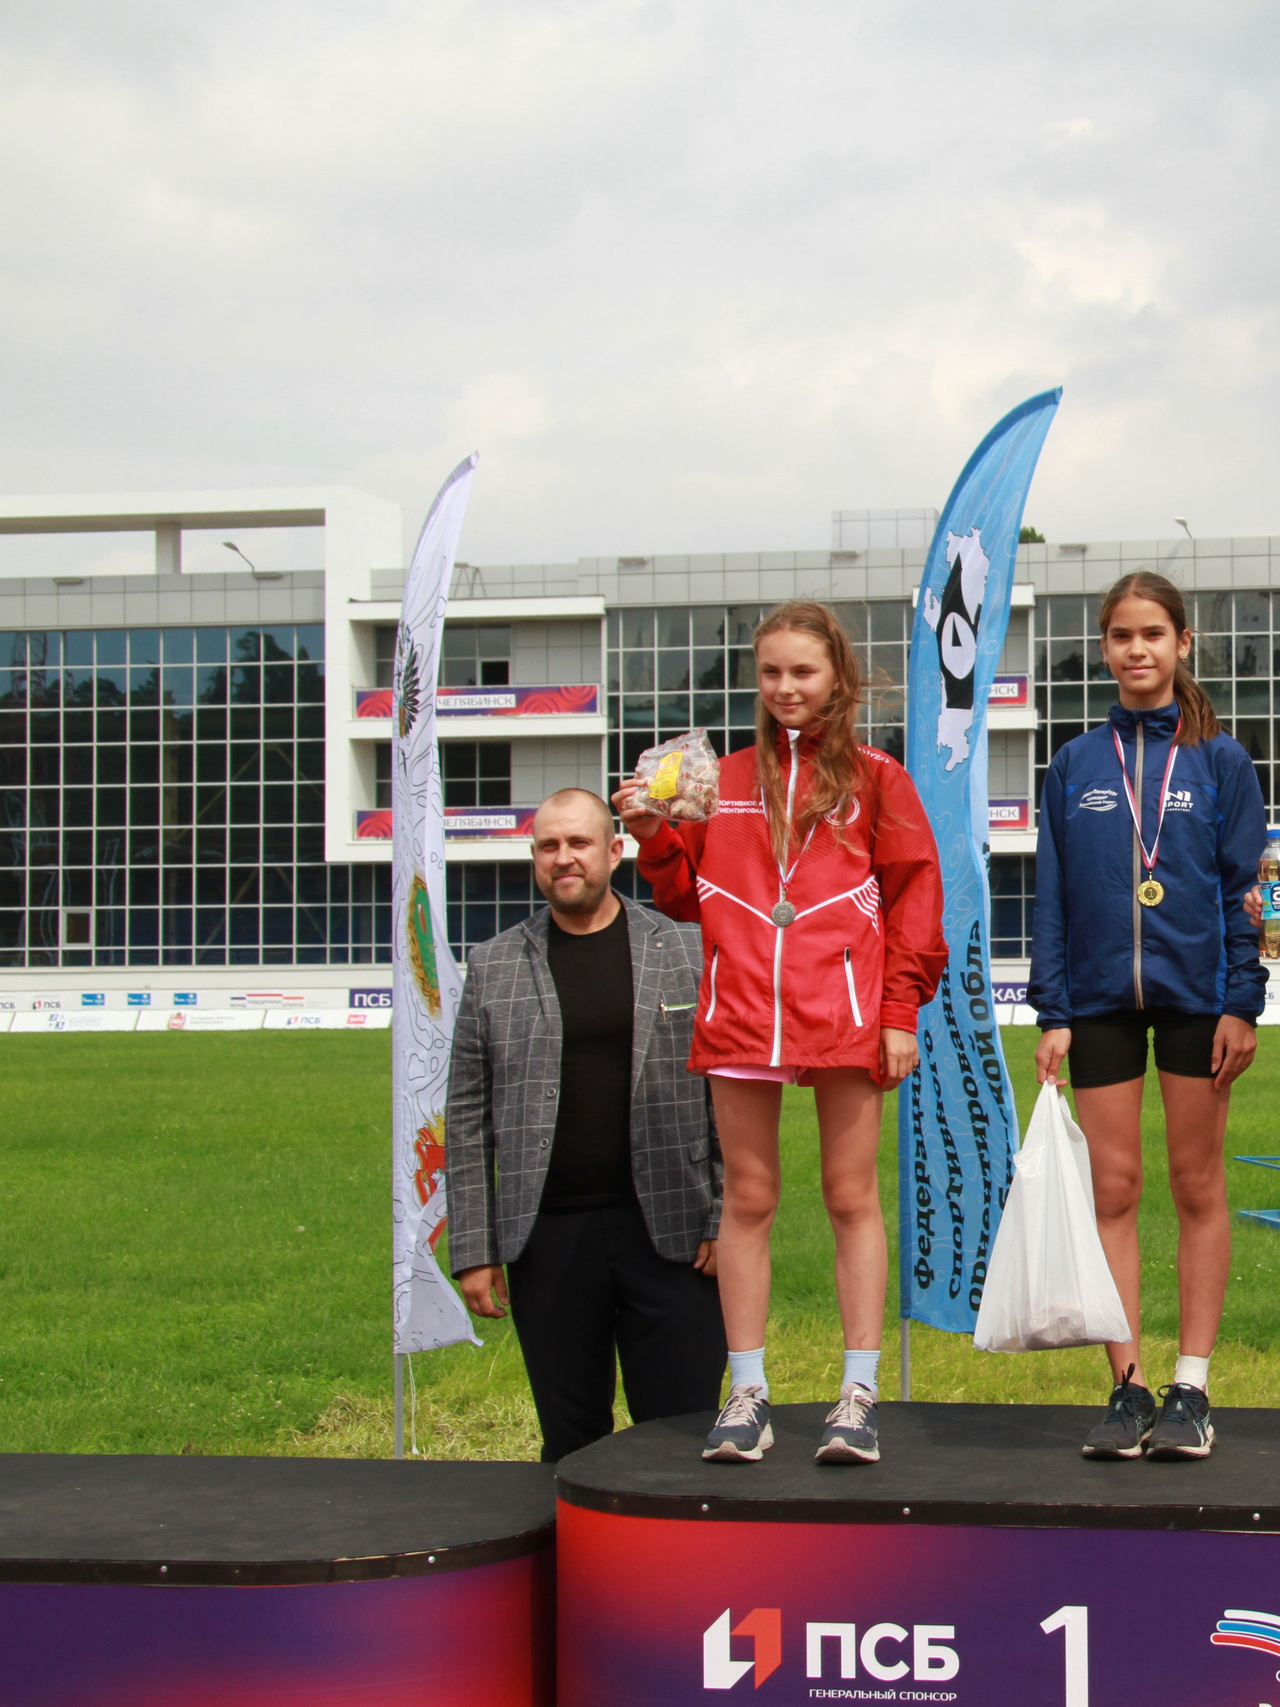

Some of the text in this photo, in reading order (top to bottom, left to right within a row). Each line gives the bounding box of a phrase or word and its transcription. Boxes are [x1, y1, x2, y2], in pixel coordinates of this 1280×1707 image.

[438, 695, 513, 707] ЧЕЛЯБИНСК
[960, 919, 990, 1021] обла
[354, 993, 391, 1007] ПСБ
[992, 988, 1027, 1002] КАЯ
[44, 1001, 61, 1009] ПСБ
[300, 1016, 321, 1024] ПСБ
[924, 1029, 964, 1300] спортивного
[805, 1622, 960, 1681] ПСБ
[1040, 1605, 1088, 1707] 1
[809, 1688, 957, 1702] ГЕНЕРАЛЬНЫЙ СПОНСОР
